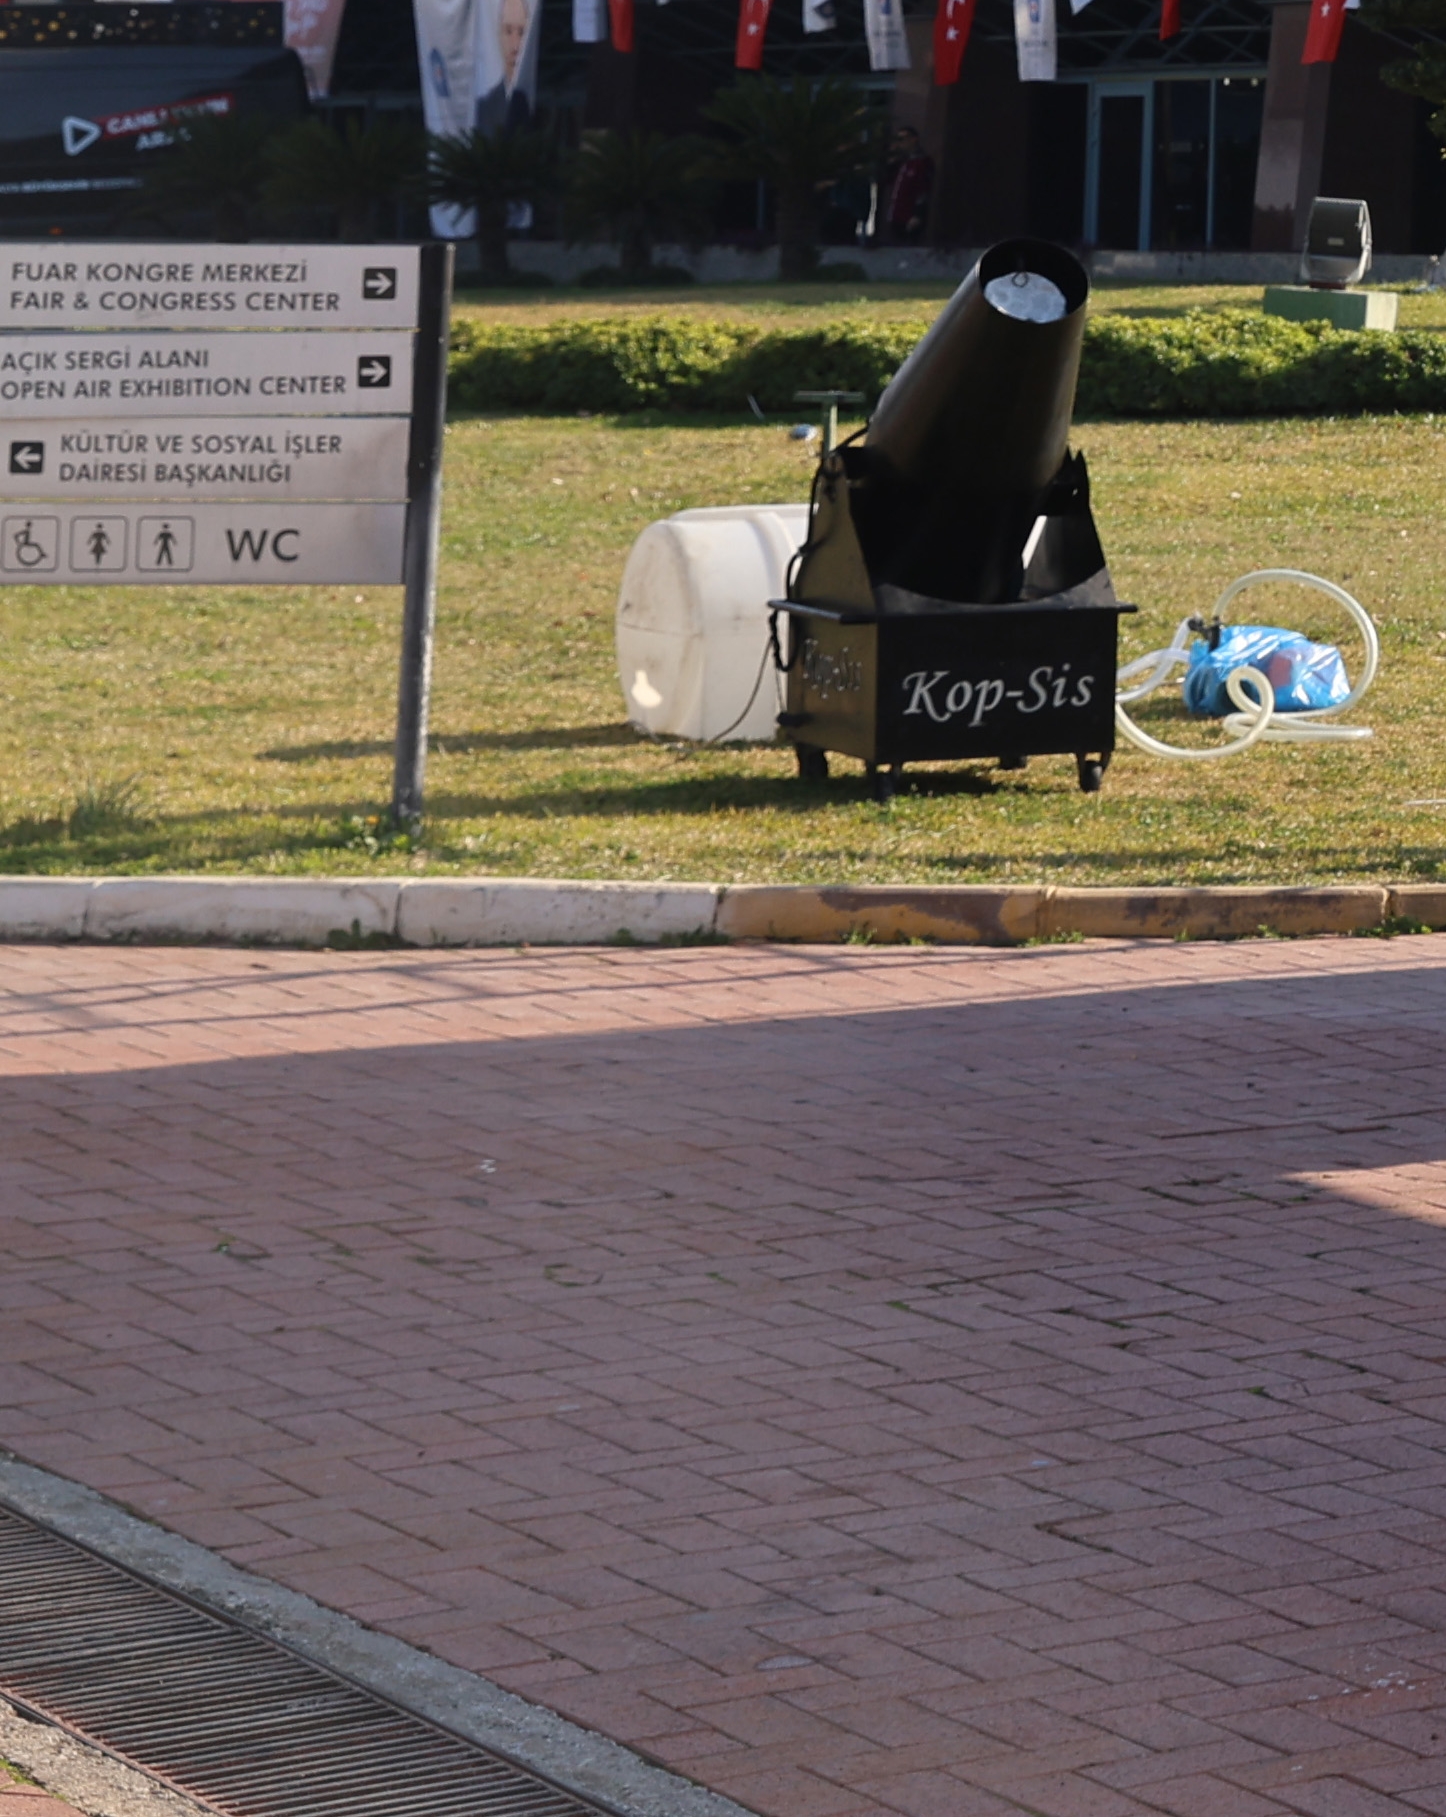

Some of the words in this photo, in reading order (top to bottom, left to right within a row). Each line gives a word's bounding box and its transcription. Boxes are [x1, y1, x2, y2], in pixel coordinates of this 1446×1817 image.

[12, 262, 77, 282] FUAR
[86, 262, 193, 282] KONGRE
[201, 259, 307, 282] MERKEZİ
[10, 291, 64, 310] FAIR
[73, 291, 89, 310] &
[99, 291, 236, 311] CONGRESS
[245, 292, 340, 311] CENTER
[1, 351, 57, 374] AÇIK
[64, 345, 131, 369] SERGİ
[138, 349, 209, 368] ALANI
[0, 381, 65, 400] OPEN
[73, 380, 112, 398] AIR
[119, 378, 250, 398] EXHIBITION
[258, 376, 346, 396] CENTER
[60, 429, 148, 454] KÜLTÜR
[156, 434, 183, 454] VE
[191, 434, 275, 454] SOSYAL
[285, 430, 342, 459] İŞLER
[59, 460, 147, 482] DAİRESİ
[154, 459, 291, 487] BAŞKANLIĞI
[226, 529, 300, 563] WC
[902, 663, 1094, 727] Kop-Sis
